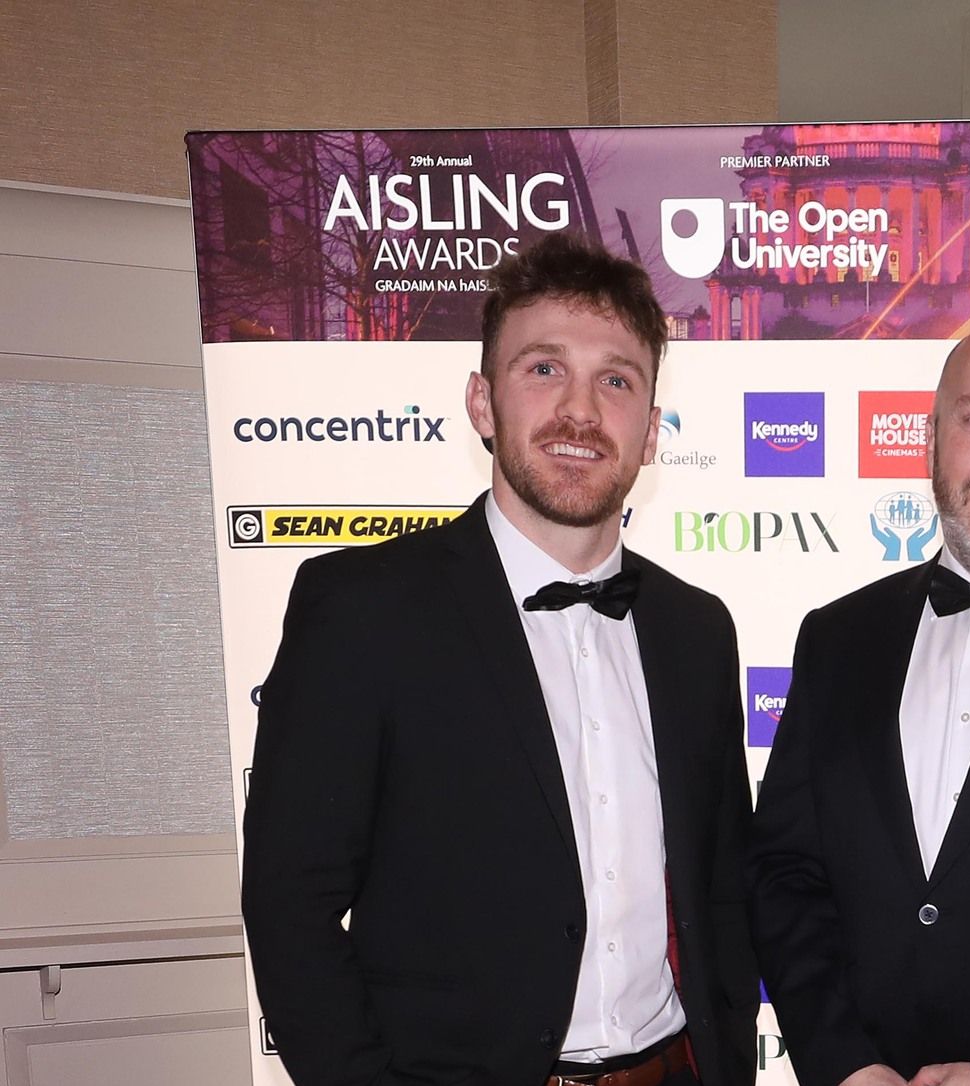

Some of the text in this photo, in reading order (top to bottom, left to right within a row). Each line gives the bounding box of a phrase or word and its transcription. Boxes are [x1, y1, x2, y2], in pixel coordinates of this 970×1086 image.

[410, 155, 472, 167] 29th Annual
[720, 154, 831, 168] PREMIER PARTNER
[323, 172, 570, 231] AISLING
[729, 201, 888, 241] The Open
[731, 236, 889, 277] University
[375, 279, 435, 292] GRADAIM
[437, 279, 457, 292] NA
[233, 404, 446, 442] concentrix
[872, 413, 929, 429] MOVIE
[752, 421, 818, 442] Kennedy
[870, 430, 928, 446] HOUSE
[660, 451, 717, 470] Gaeilge
[882, 449, 918, 457] CINEMAS
[272, 516, 344, 536] SEAN
